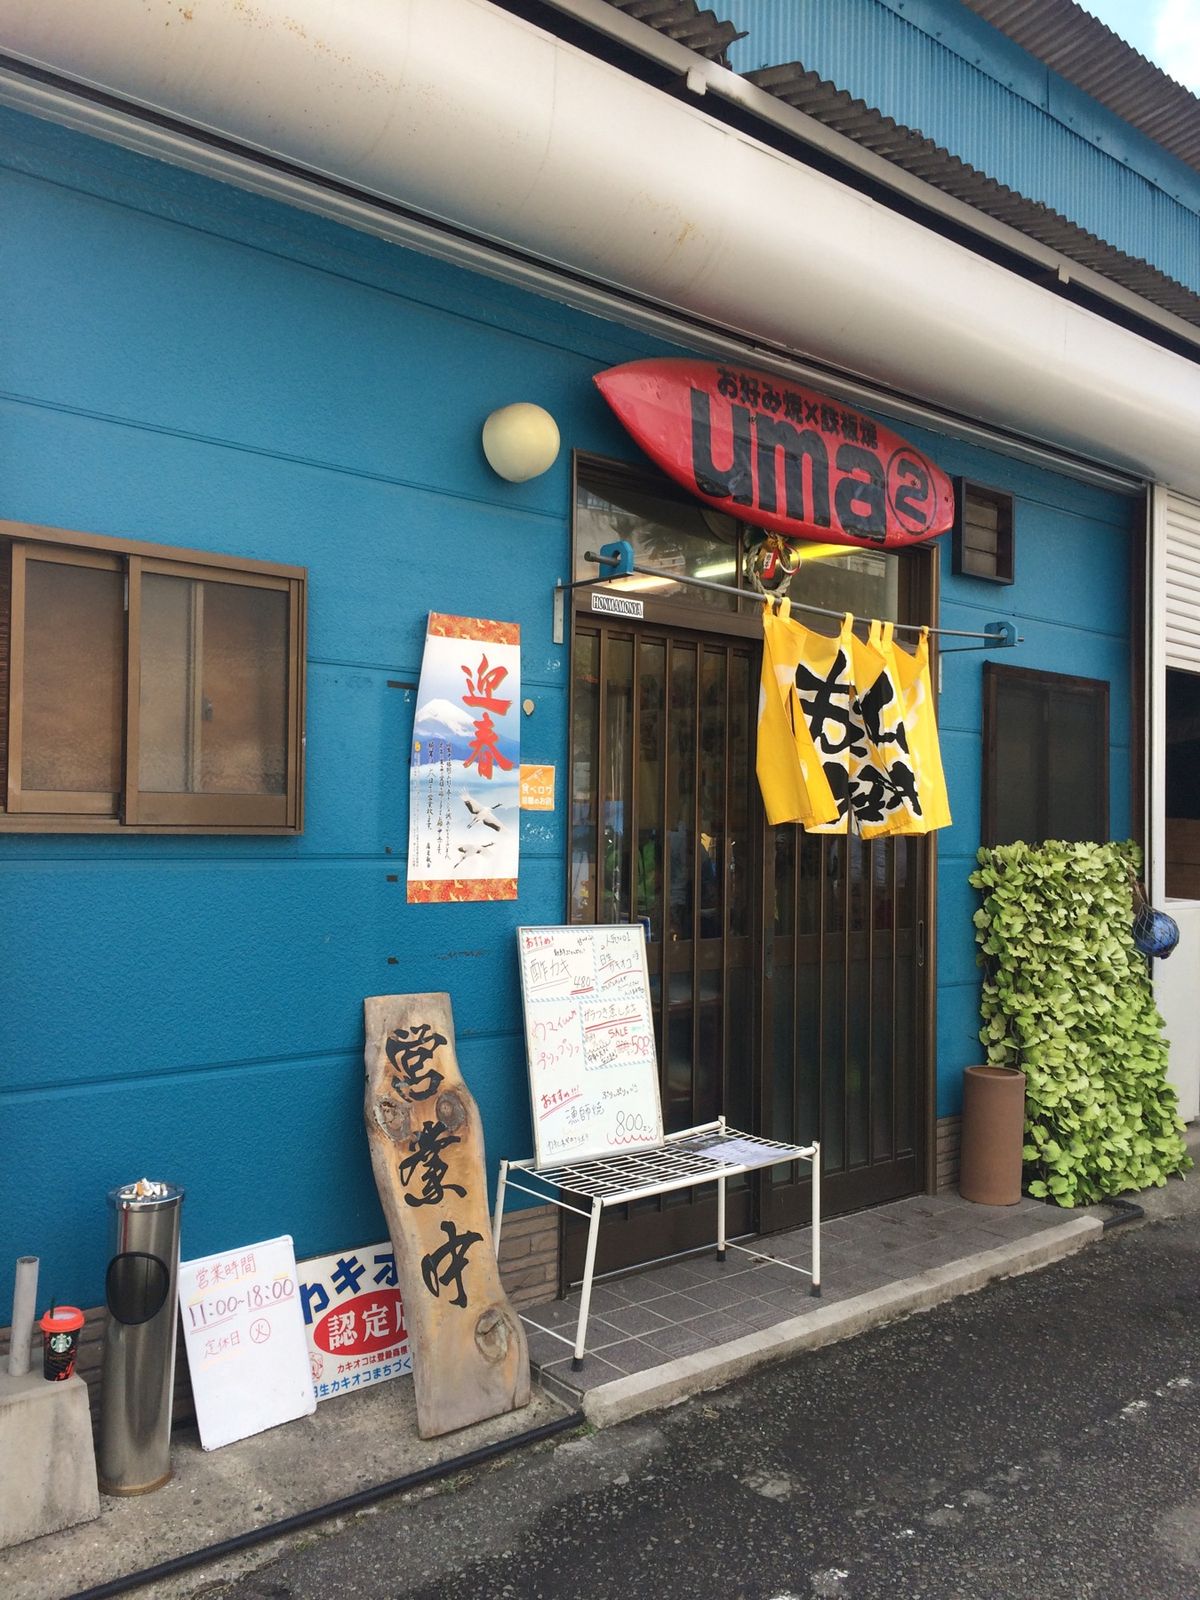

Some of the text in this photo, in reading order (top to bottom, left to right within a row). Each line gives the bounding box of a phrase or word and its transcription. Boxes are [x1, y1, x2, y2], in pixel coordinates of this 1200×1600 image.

[593, 595, 642, 616] HONMAMONYA
[461, 653, 514, 780] 迎春
[608, 1026, 629, 1039] SALE
[385, 1023, 484, 1307] 営業中
[196, 1253, 257, 1289] 営業時間
[204, 1330, 240, 1358] 定休日
